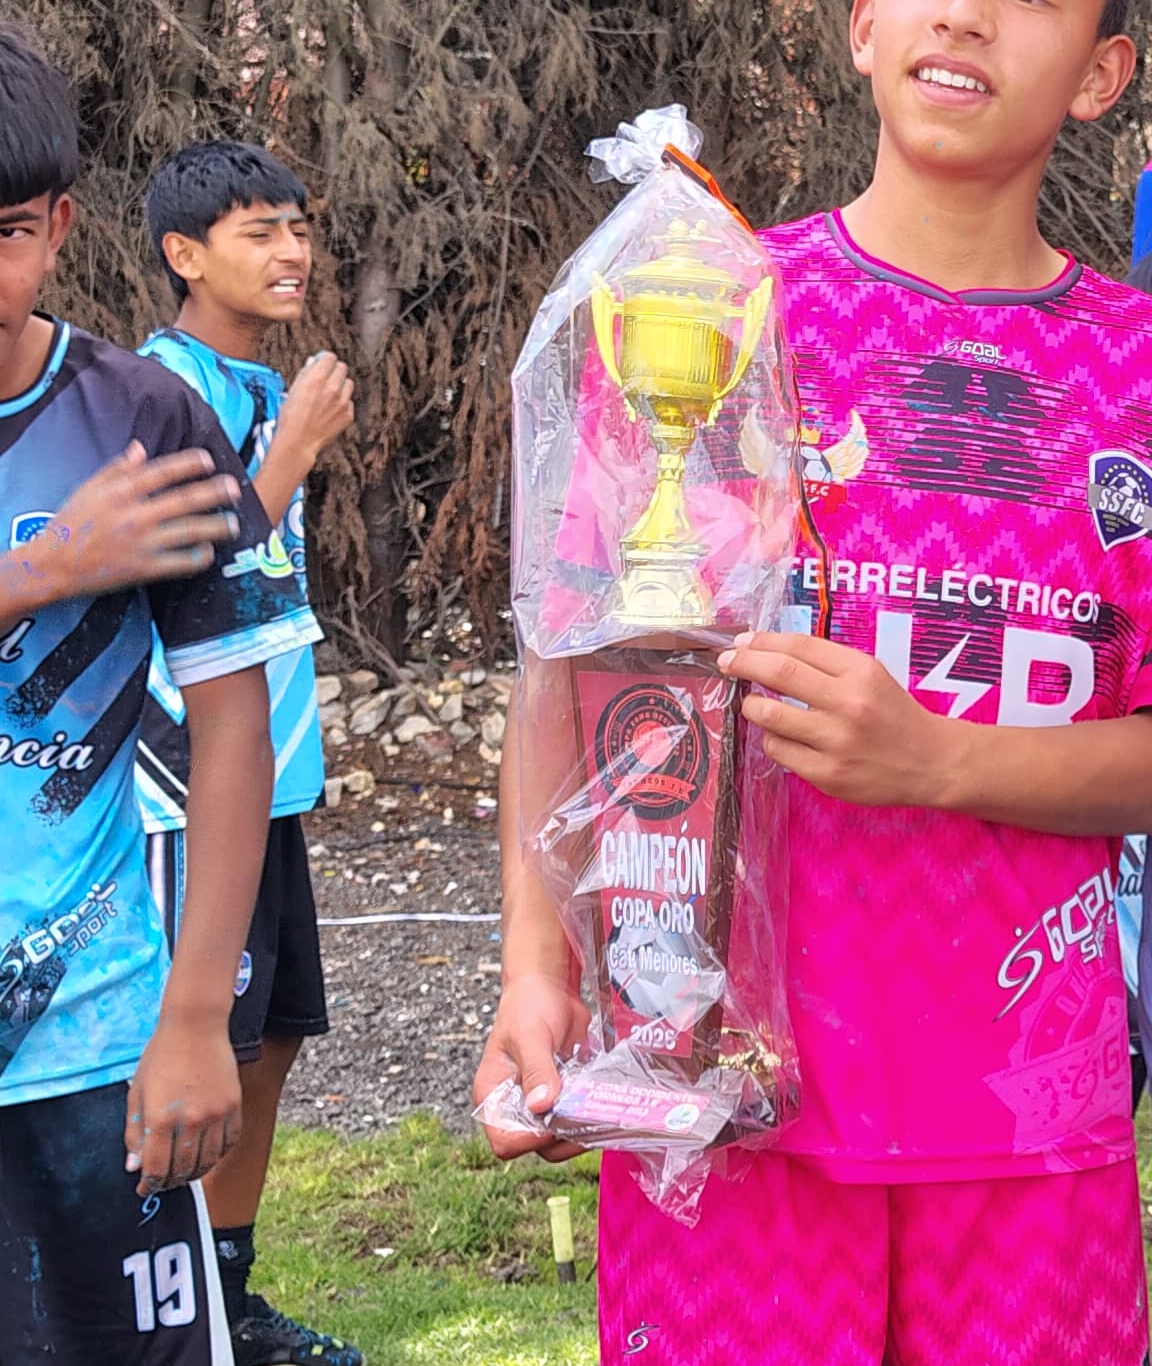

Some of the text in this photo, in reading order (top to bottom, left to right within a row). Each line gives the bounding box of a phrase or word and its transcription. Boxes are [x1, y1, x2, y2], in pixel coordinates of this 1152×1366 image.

[1099, 488, 1145, 525] SSFC
[790, 557, 1101, 625] ERRELÉCTRICOS
[600, 821, 706, 896] CAMPEÓN
[611, 897, 656, 929] COPA
[638, 946, 698, 975] Menores
[122, 1241, 196, 1333] 19
